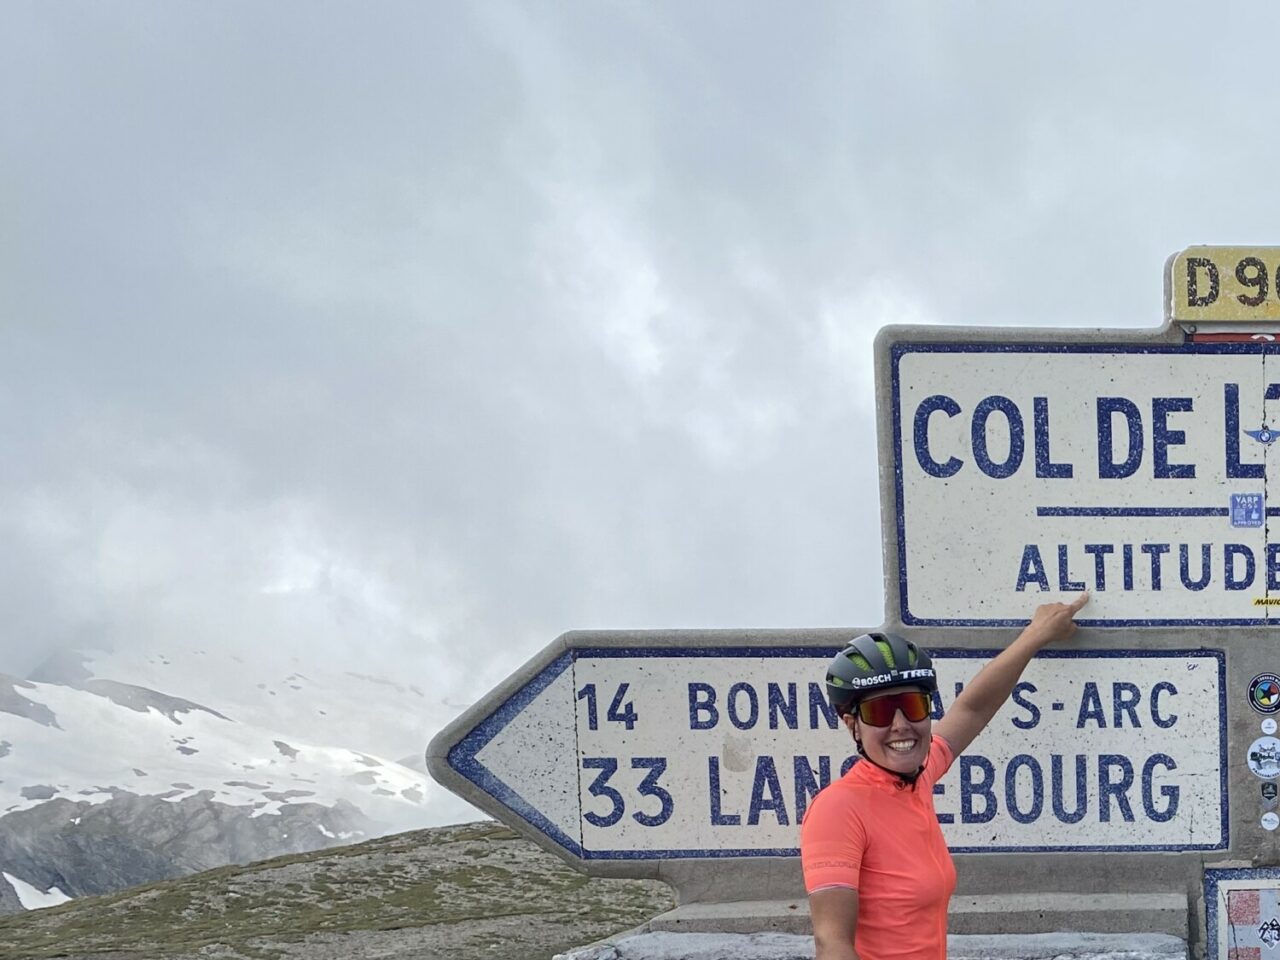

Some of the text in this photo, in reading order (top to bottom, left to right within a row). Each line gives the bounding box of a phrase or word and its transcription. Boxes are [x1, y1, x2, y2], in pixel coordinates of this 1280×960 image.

[1187, 257, 1220, 307] D
[913, 395, 1073, 479] COL
[1097, 395, 1196, 479] DE
[861, 673, 892, 687] BOSCH
[577, 682, 637, 732] 14
[582, 755, 674, 828] 33
